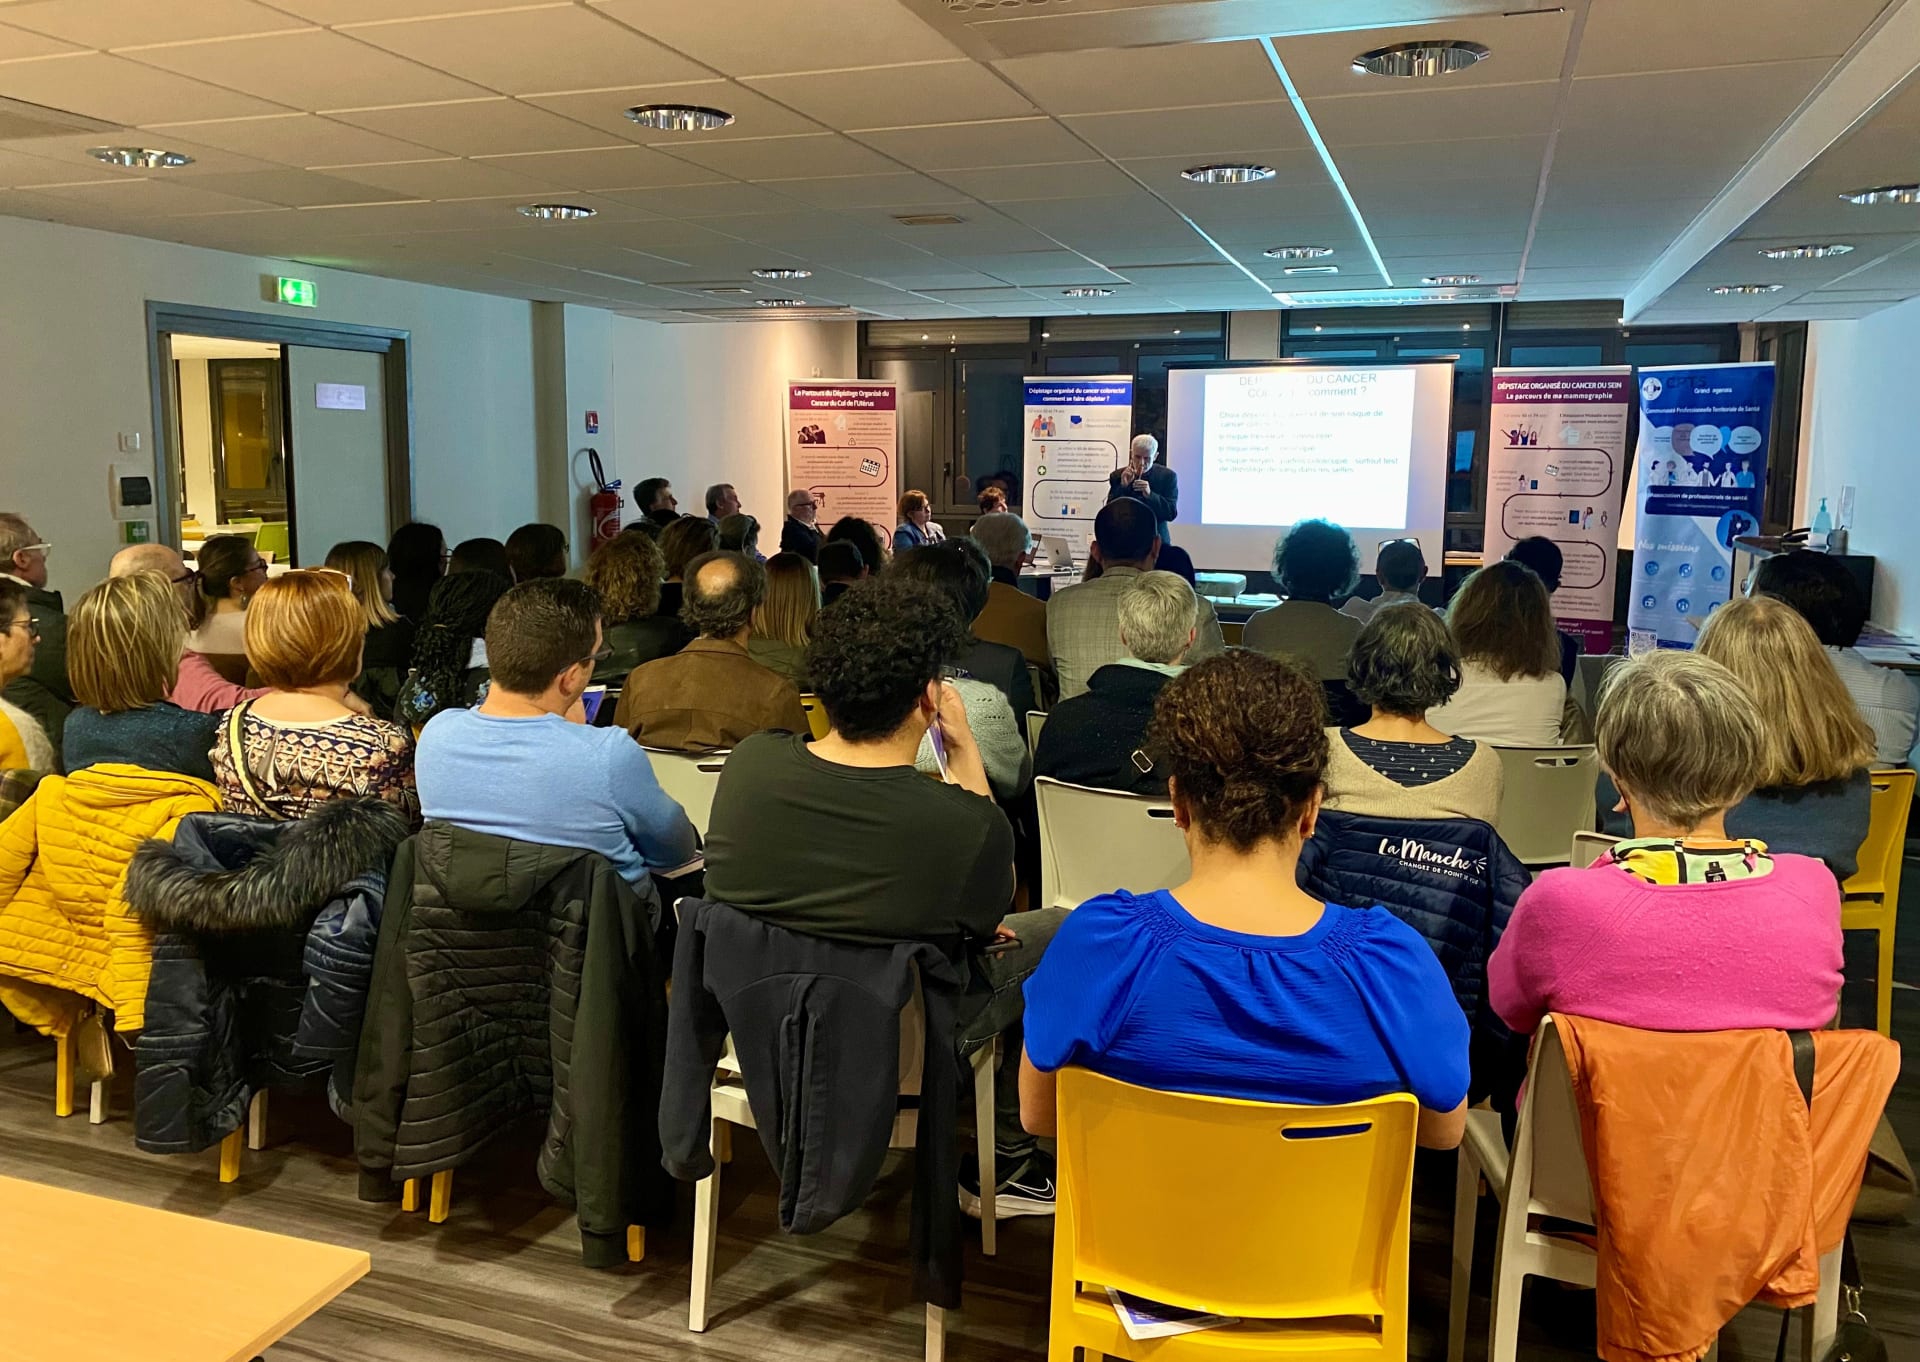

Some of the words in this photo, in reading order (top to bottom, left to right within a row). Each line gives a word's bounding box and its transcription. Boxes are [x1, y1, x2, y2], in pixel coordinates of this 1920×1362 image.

[1326, 373, 1376, 384] CANCER
[1497, 382, 1529, 390] DÉPISTAGE
[1530, 380, 1560, 390] ORGANISÉ
[833, 389, 858, 398] Dépistage
[859, 390, 881, 398] Organisé
[1308, 386, 1356, 396] comment
[1563, 392, 1612, 400] mammographie
[1657, 541, 1700, 552] missions
[1378, 838, 1400, 855] La
[1401, 838, 1471, 870] Manche
[1443, 870, 1463, 879] POINT
